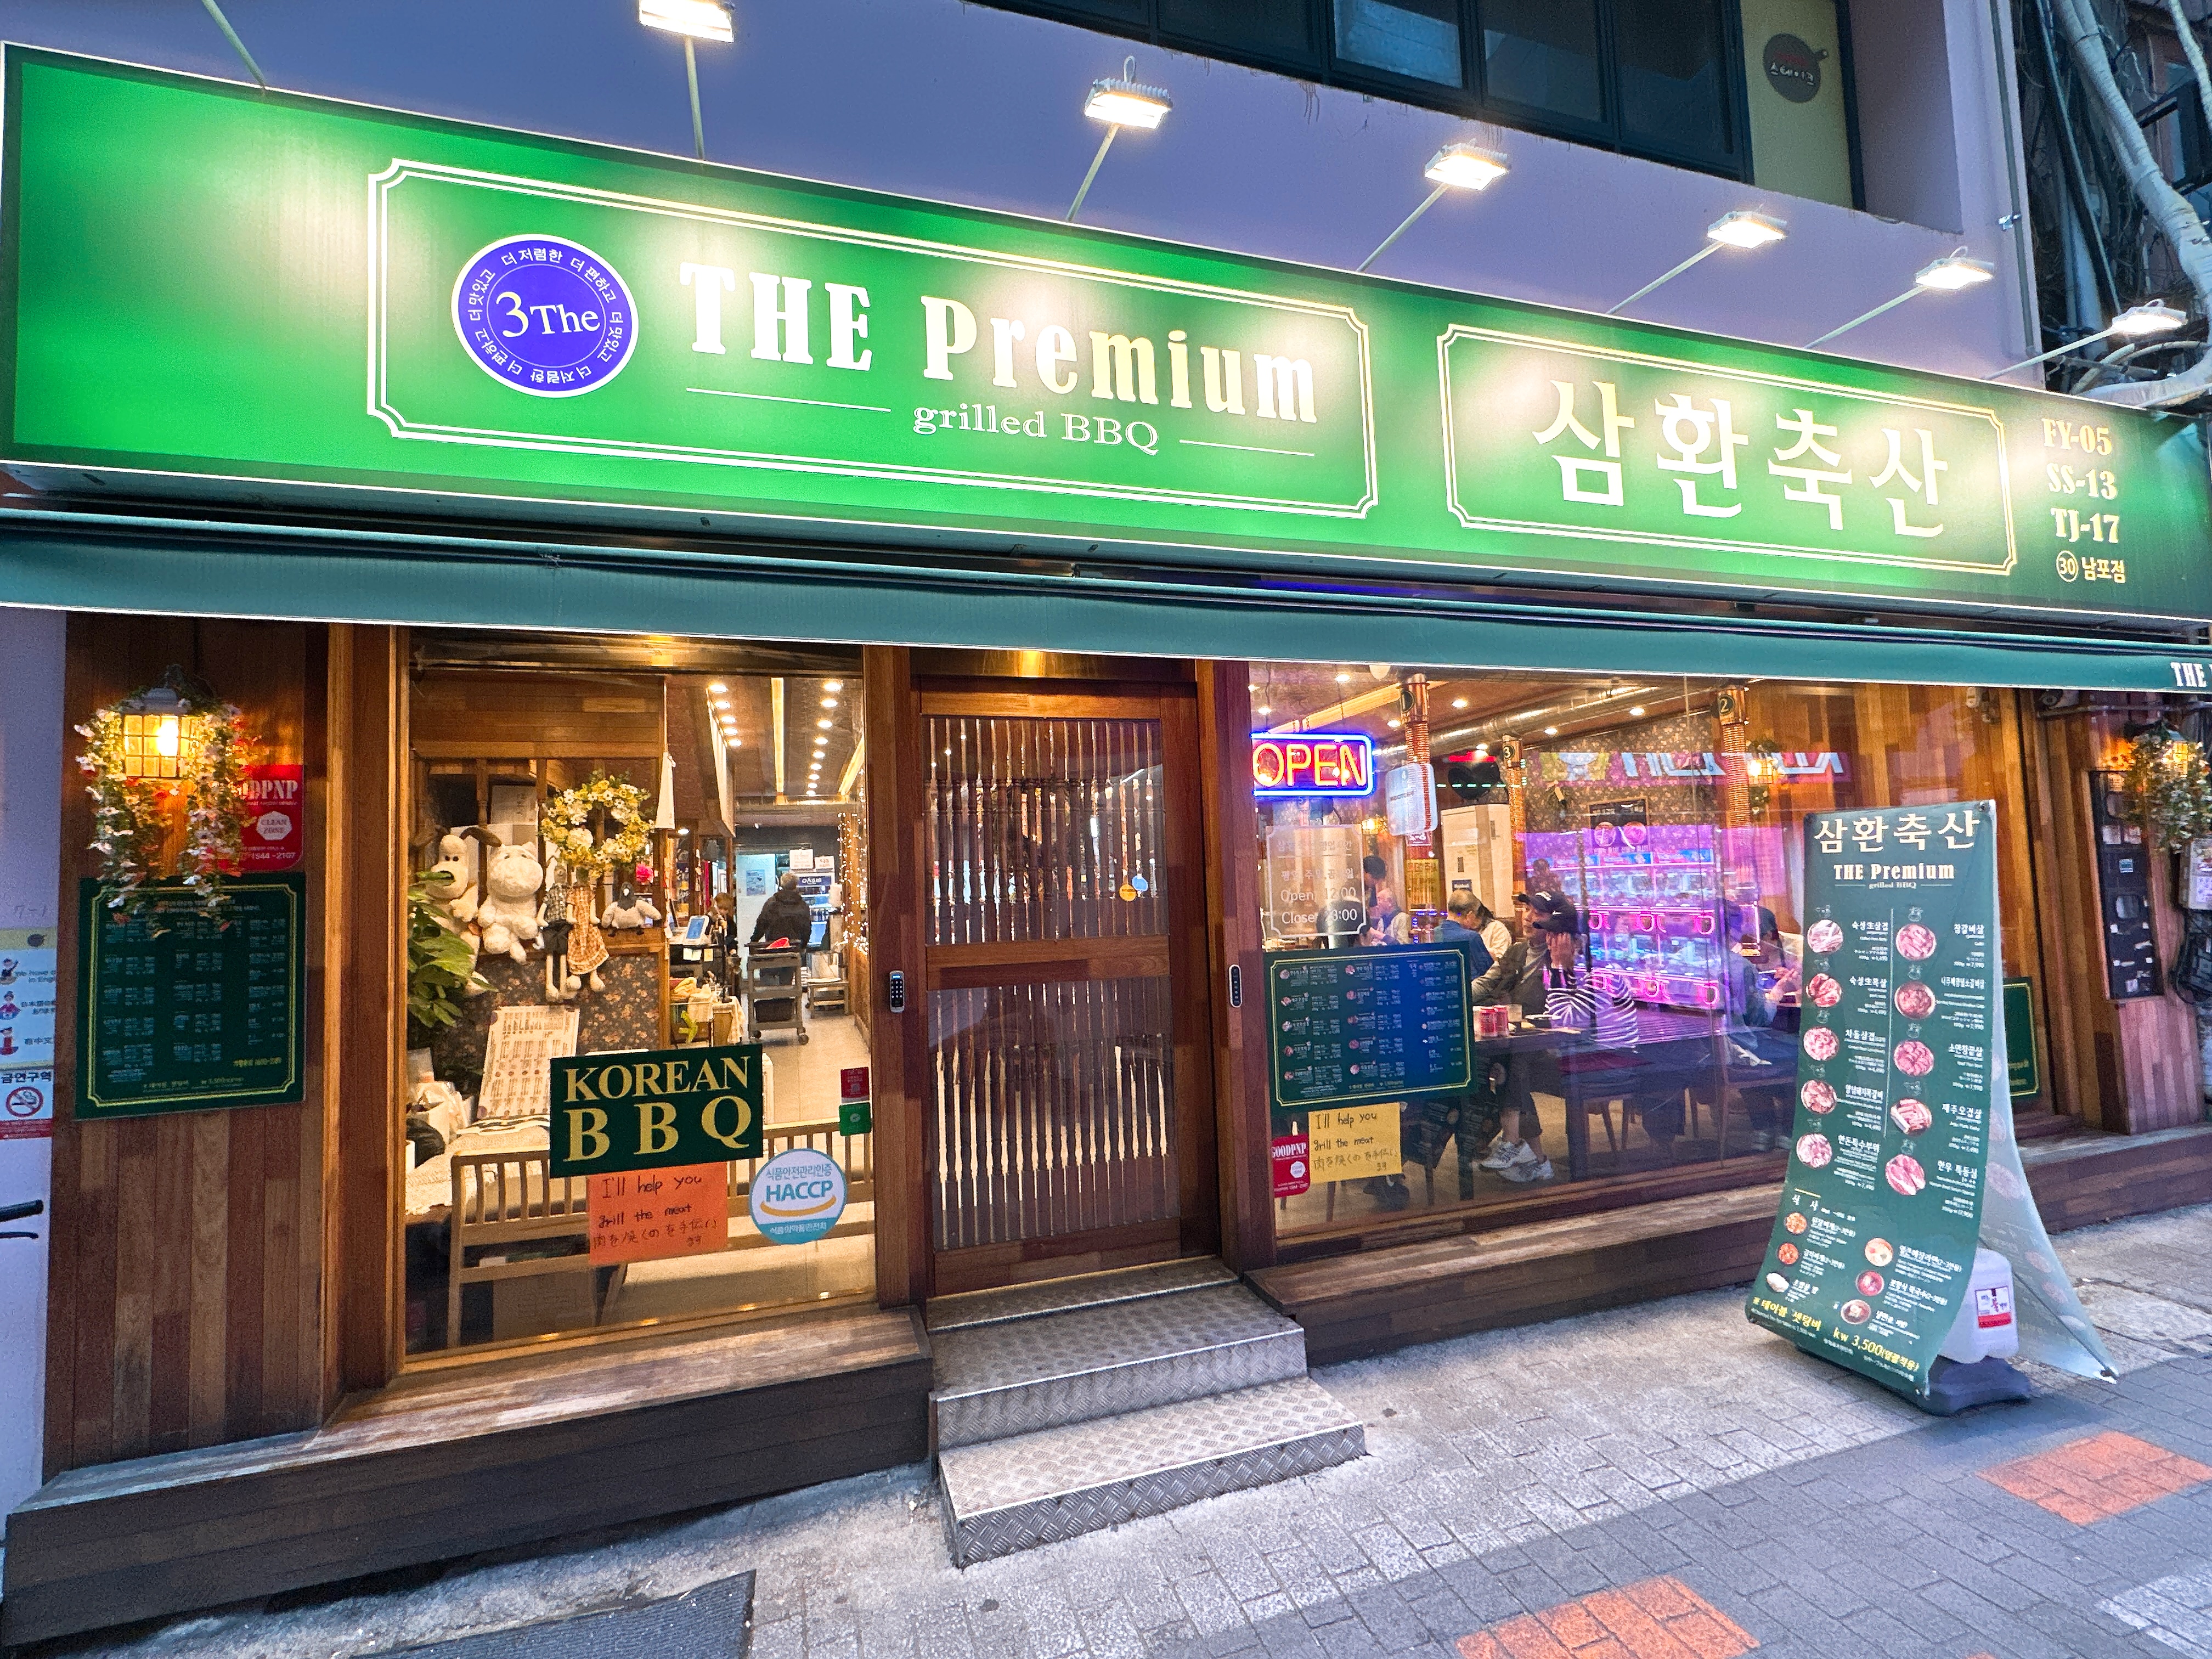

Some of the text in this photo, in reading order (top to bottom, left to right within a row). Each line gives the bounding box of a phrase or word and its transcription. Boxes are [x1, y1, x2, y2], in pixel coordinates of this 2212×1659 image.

[501, 247, 563, 266] 더 저렴한
[570, 257, 617, 303] 더 편하고
[467, 269, 495, 321] 더 맛있고
[597, 312, 623, 362] 더 맛있고
[680, 262, 1317, 423] THE Premium
[475, 328, 522, 375] 더 편하고
[531, 366, 592, 384] 더 저렴한
[913, 403, 1159, 455] grilled BBQ
[2042, 418, 2112, 456] FY-05
[1532, 380, 1948, 537] 삼환축산
[2047, 463, 2117, 500] SS-13
[2051, 507, 2119, 544] TJ-17
[2081, 557, 2126, 584] 남포점
[2171, 662, 2207, 688] THE
[1720, 698, 1729, 713] 2
[1253, 743, 1367, 787] OPEN
[1504, 746, 1511, 759] 3
[1814, 810, 1981, 854] 삼환축산
[1833, 862, 1954, 880] THE Premium
[1281, 889, 1314, 902] Open
[1282, 912, 1316, 924] Close
[1, 1071, 51, 1084] 금연구역
[563, 1056, 752, 1103] KOREAN
[1338, 1112, 1354, 1128] help
[1359, 1112, 1378, 1122] you
[1313, 1136, 1374, 1152] grill the meat
[766, 1163, 833, 1180] 식품안전관리인증
[1938, 1160, 1953, 1172] 한우
[602, 1175, 702, 1198] I'll help you
[766, 1180, 833, 1203] HACCP
[599, 1203, 692, 1229] grill the meat
[1761, 1299, 1787, 1318] 테이블
